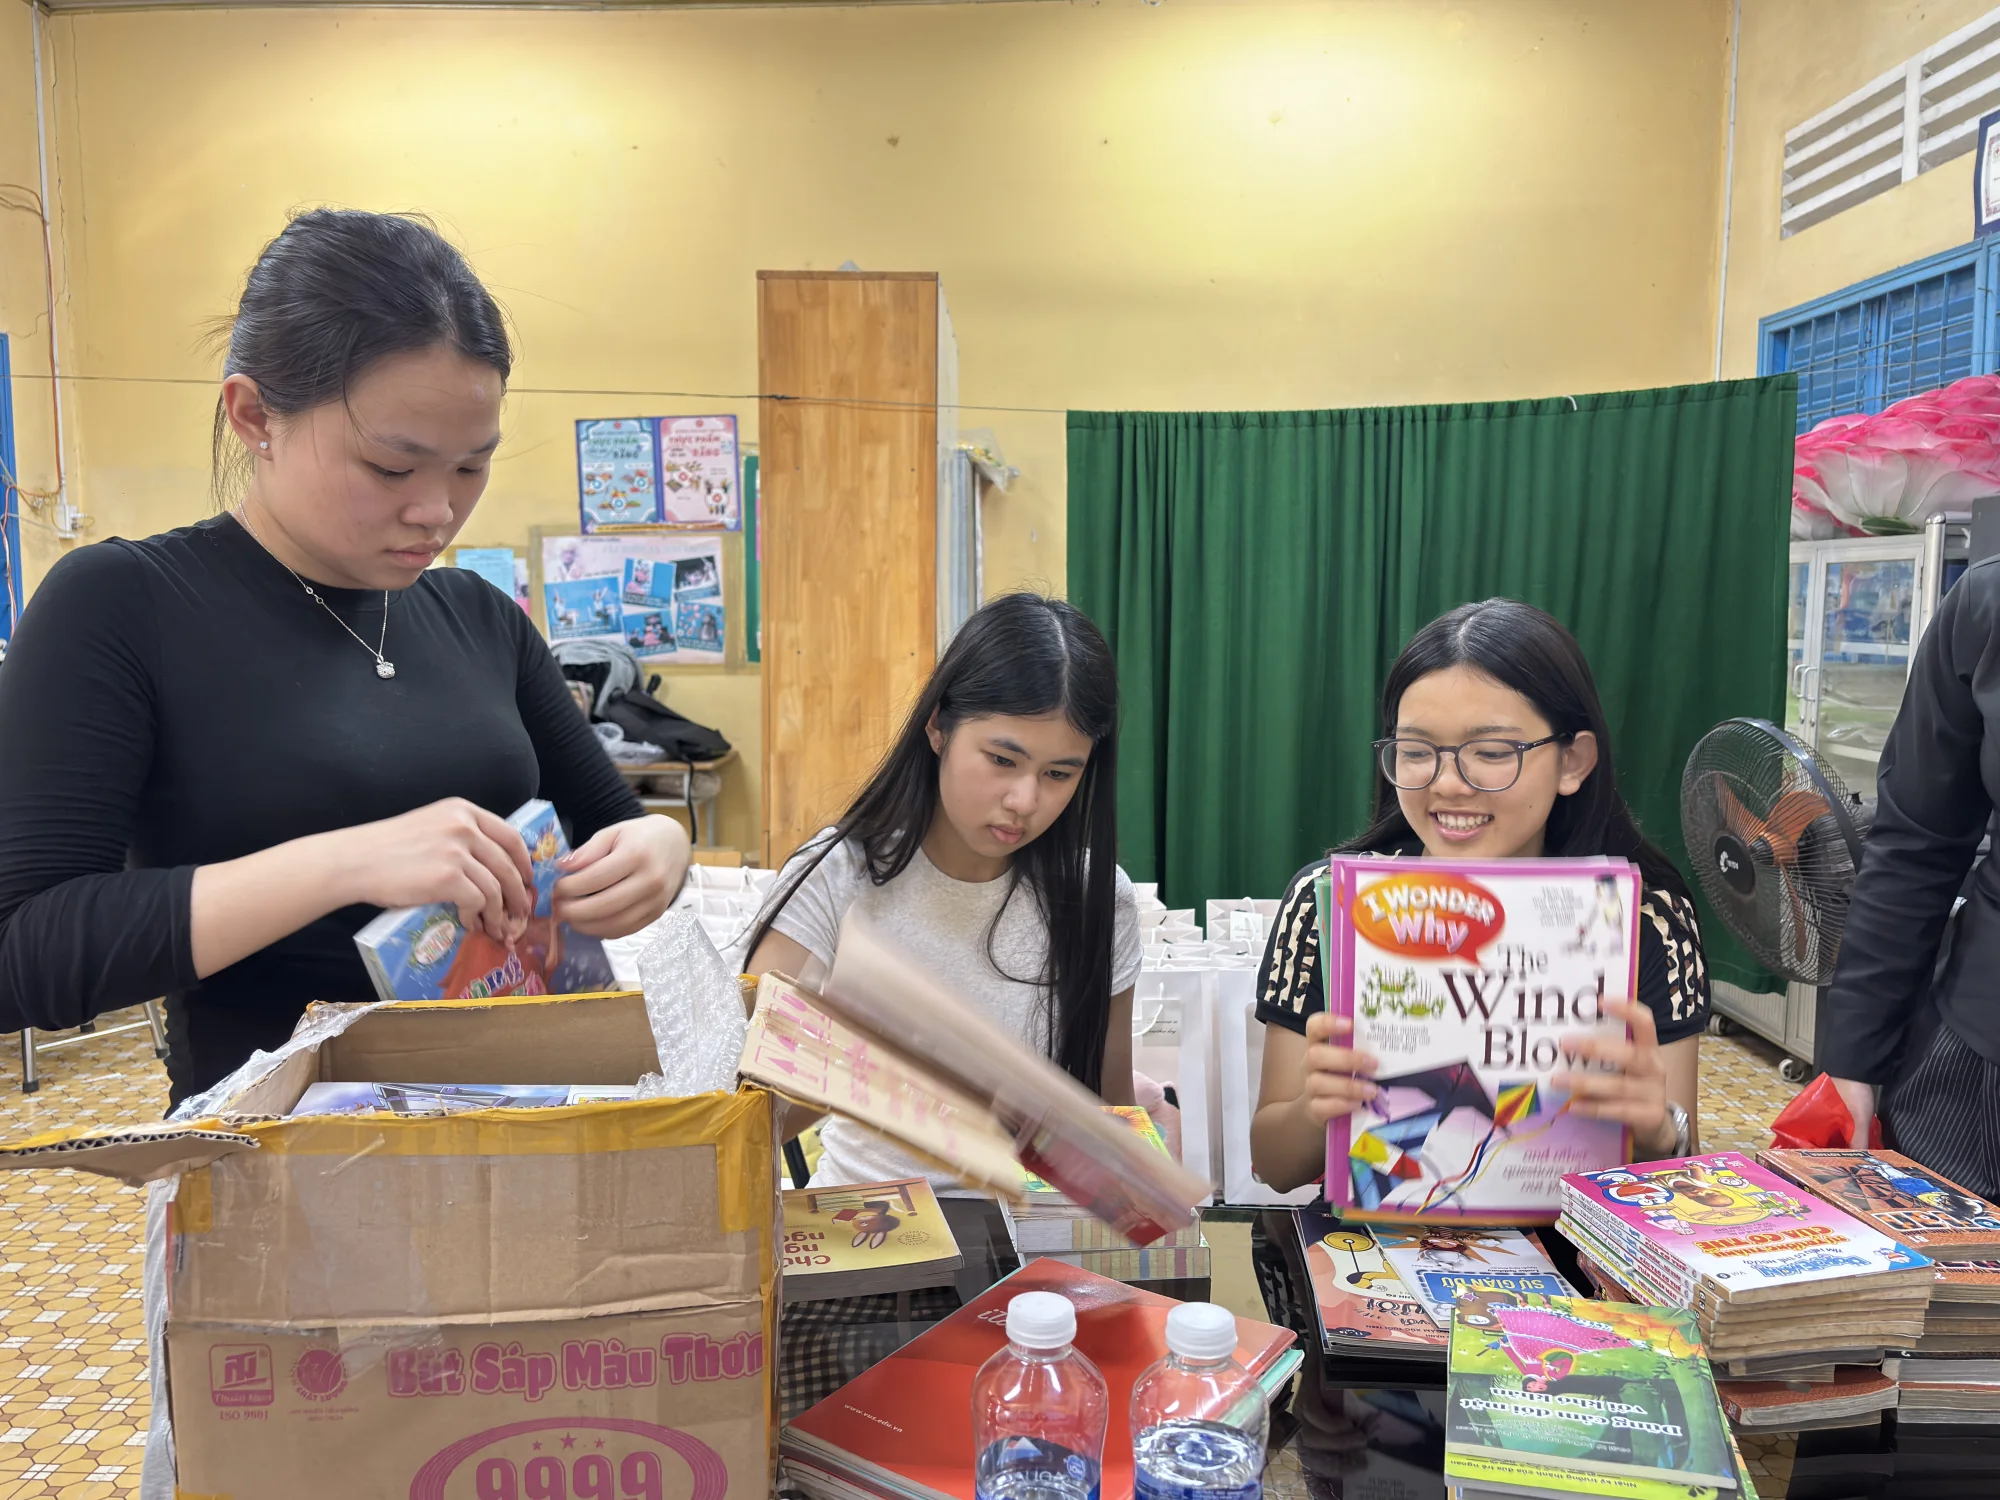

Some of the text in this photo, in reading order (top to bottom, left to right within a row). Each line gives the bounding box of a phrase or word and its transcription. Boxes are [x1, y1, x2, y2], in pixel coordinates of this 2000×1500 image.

[1361, 891, 1382, 921] I
[1383, 883, 1497, 928] WONDER
[1387, 911, 1470, 954] Why
[1498, 943, 1549, 974] The
[1440, 966, 1610, 1025] Wind
[1518, 1278, 1545, 1290] SỰ
[470, 1340, 558, 1402] Sáp
[561, 1338, 656, 1393] Màu
[1489, 1387, 1648, 1415] với khó khăn
[219, 1410, 241, 1421] ISO
[1459, 1397, 1683, 1437] Dũng cảm đối mặt
[1450, 1459, 1480, 1468] ngoan
[1536, 1471, 1564, 1480] thành
[1599, 1478, 1613, 1486] ký
[1614, 1480, 1637, 1489] Nhật
